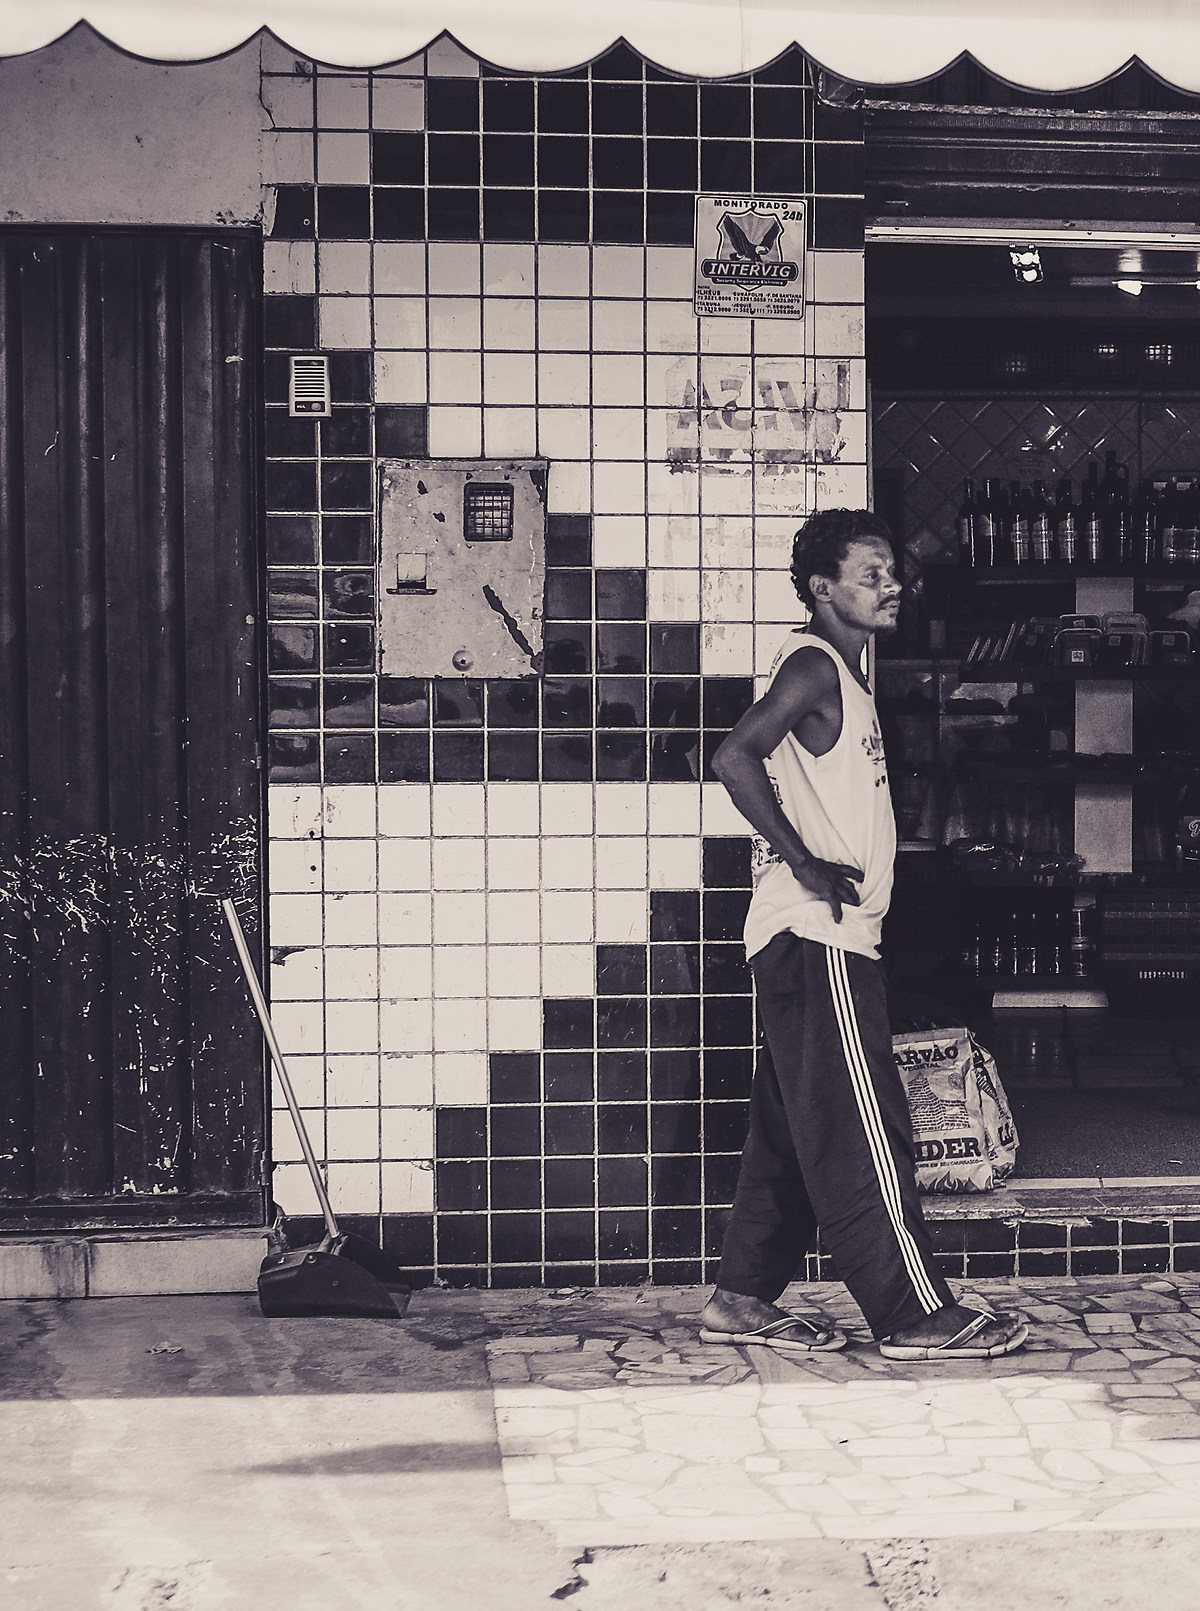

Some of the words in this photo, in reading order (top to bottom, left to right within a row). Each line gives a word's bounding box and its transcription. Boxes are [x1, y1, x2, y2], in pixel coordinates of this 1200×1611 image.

[714, 199, 788, 210] MONITORADO
[782, 210, 803, 221] 24h
[708, 262, 791, 278] INTERVIG
[893, 1044, 960, 1066] ARVÃO
[914, 1137, 981, 1161] IDER
